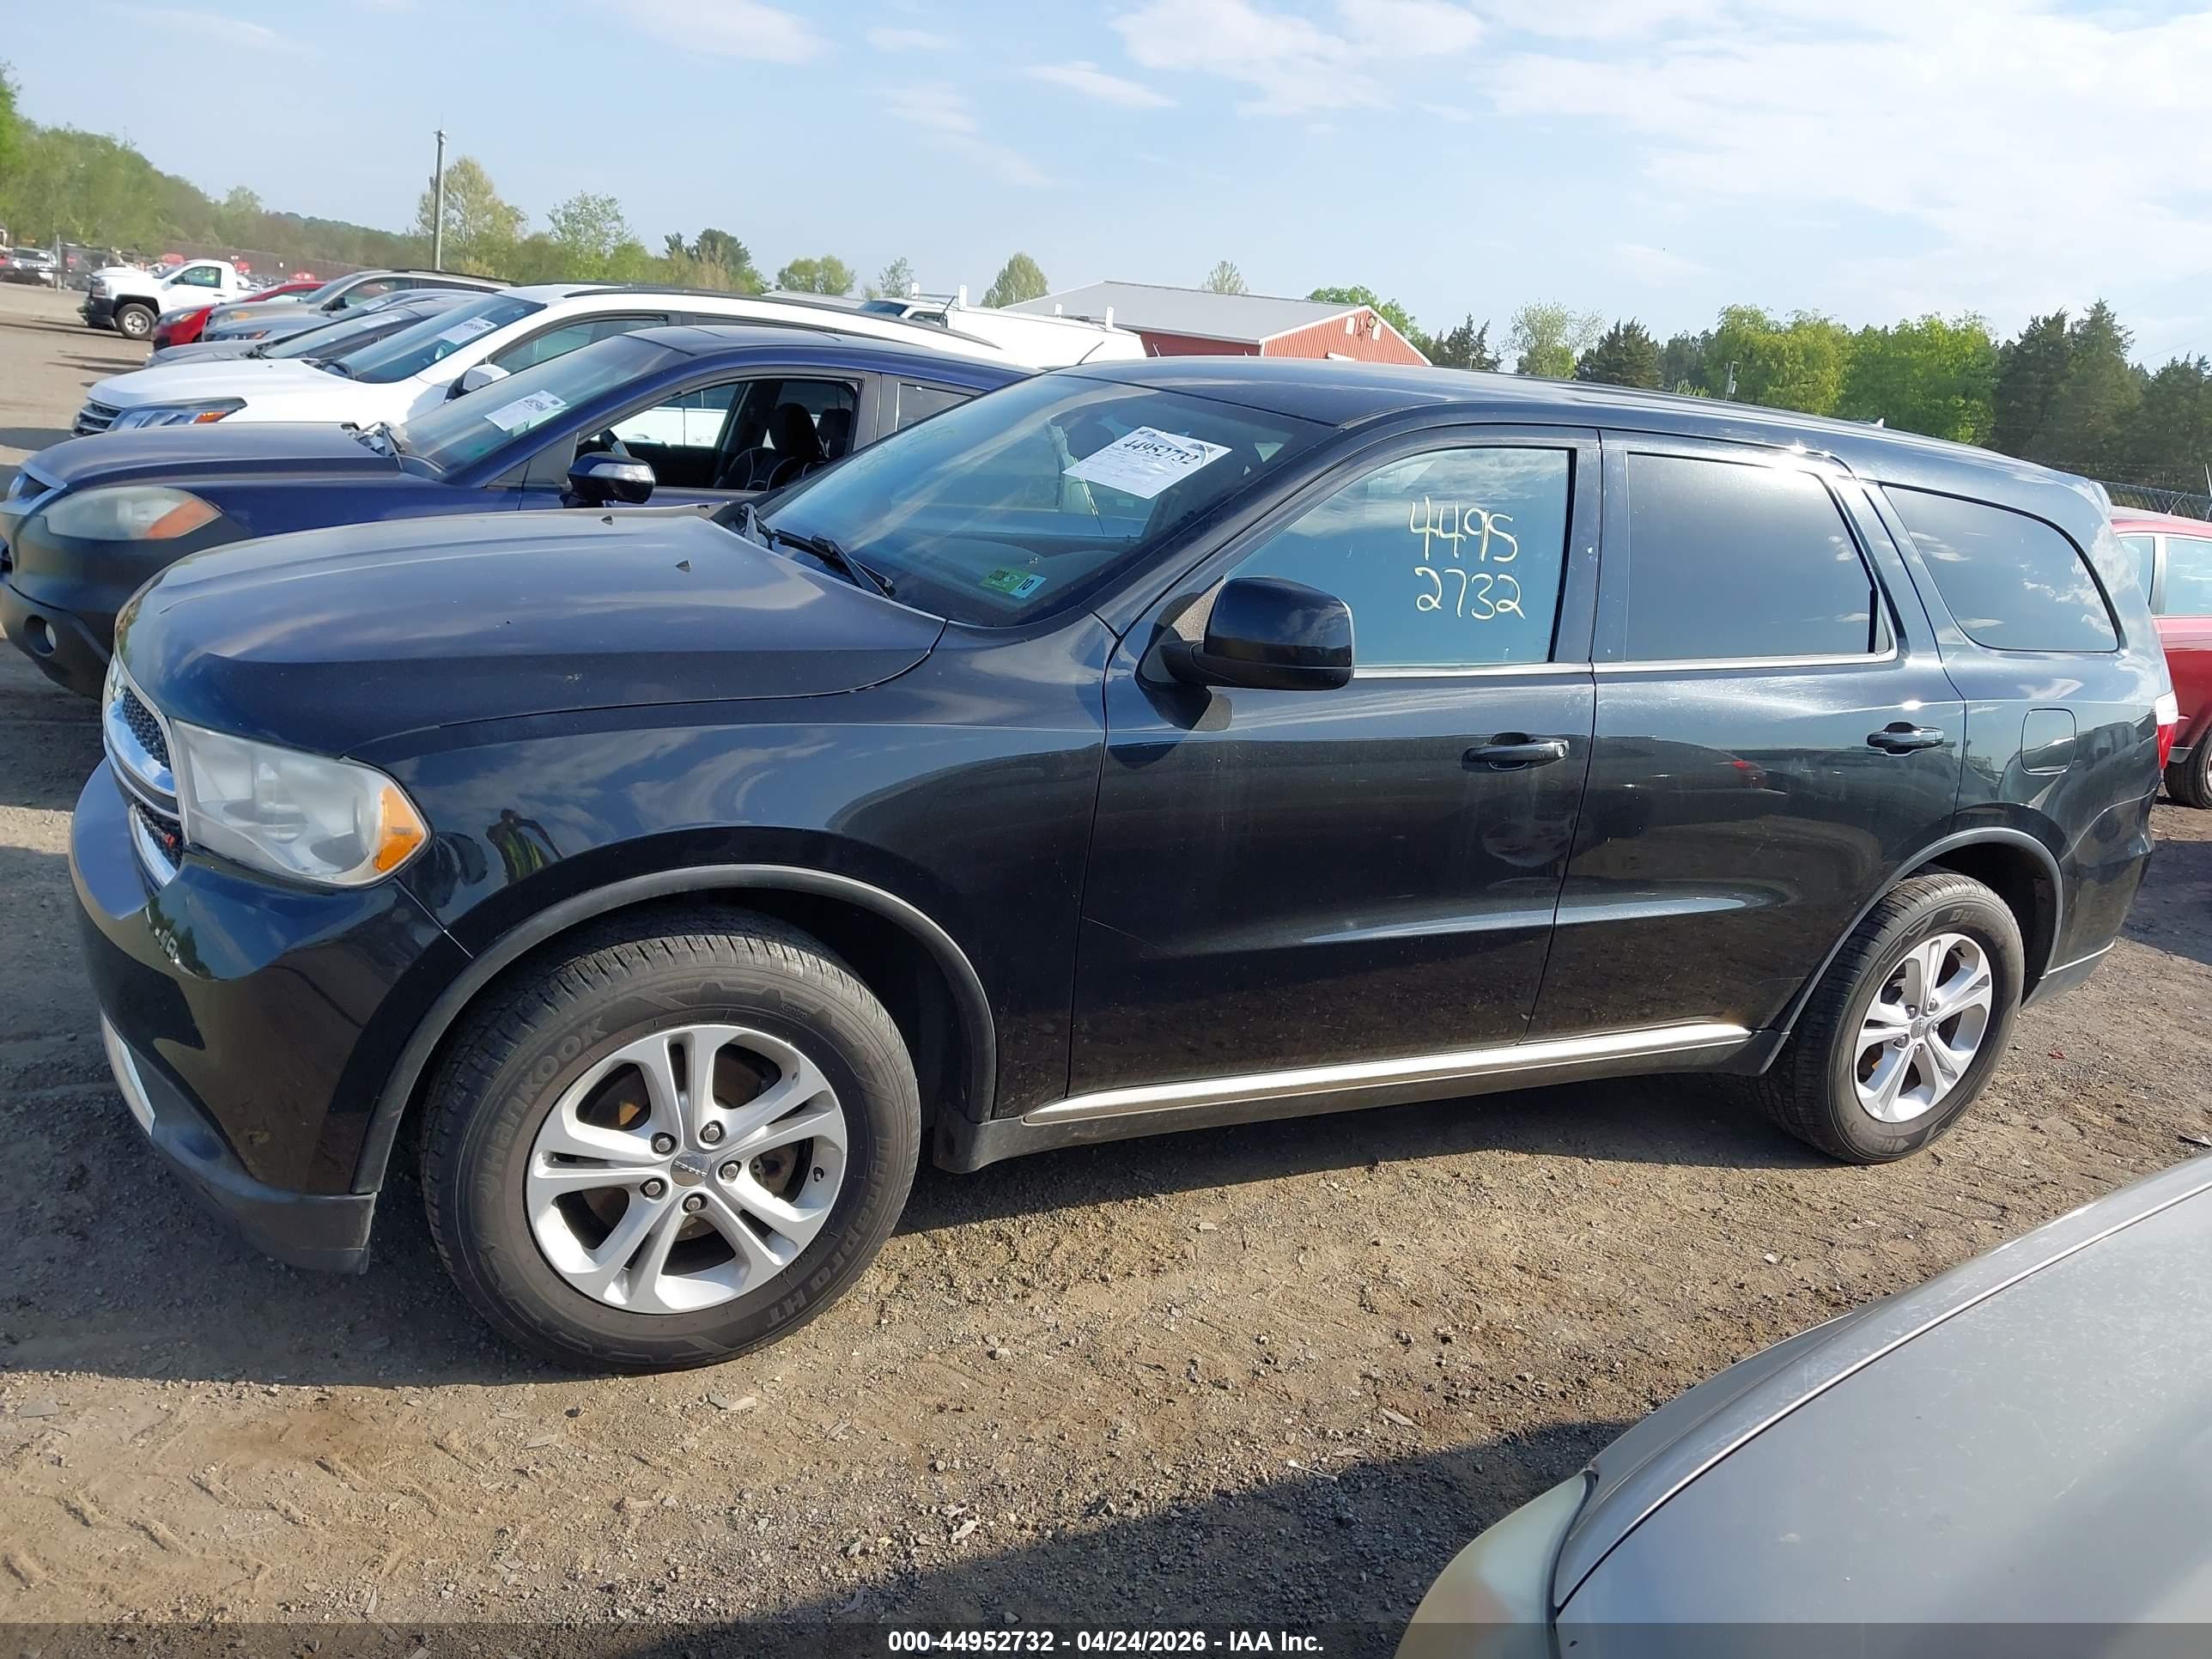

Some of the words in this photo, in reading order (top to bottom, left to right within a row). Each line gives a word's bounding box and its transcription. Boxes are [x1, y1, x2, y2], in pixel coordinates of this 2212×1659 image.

[1122, 439, 1200, 465] 44952732
[1409, 495, 1518, 562] 4495
[1414, 566, 1526, 620] 2732
